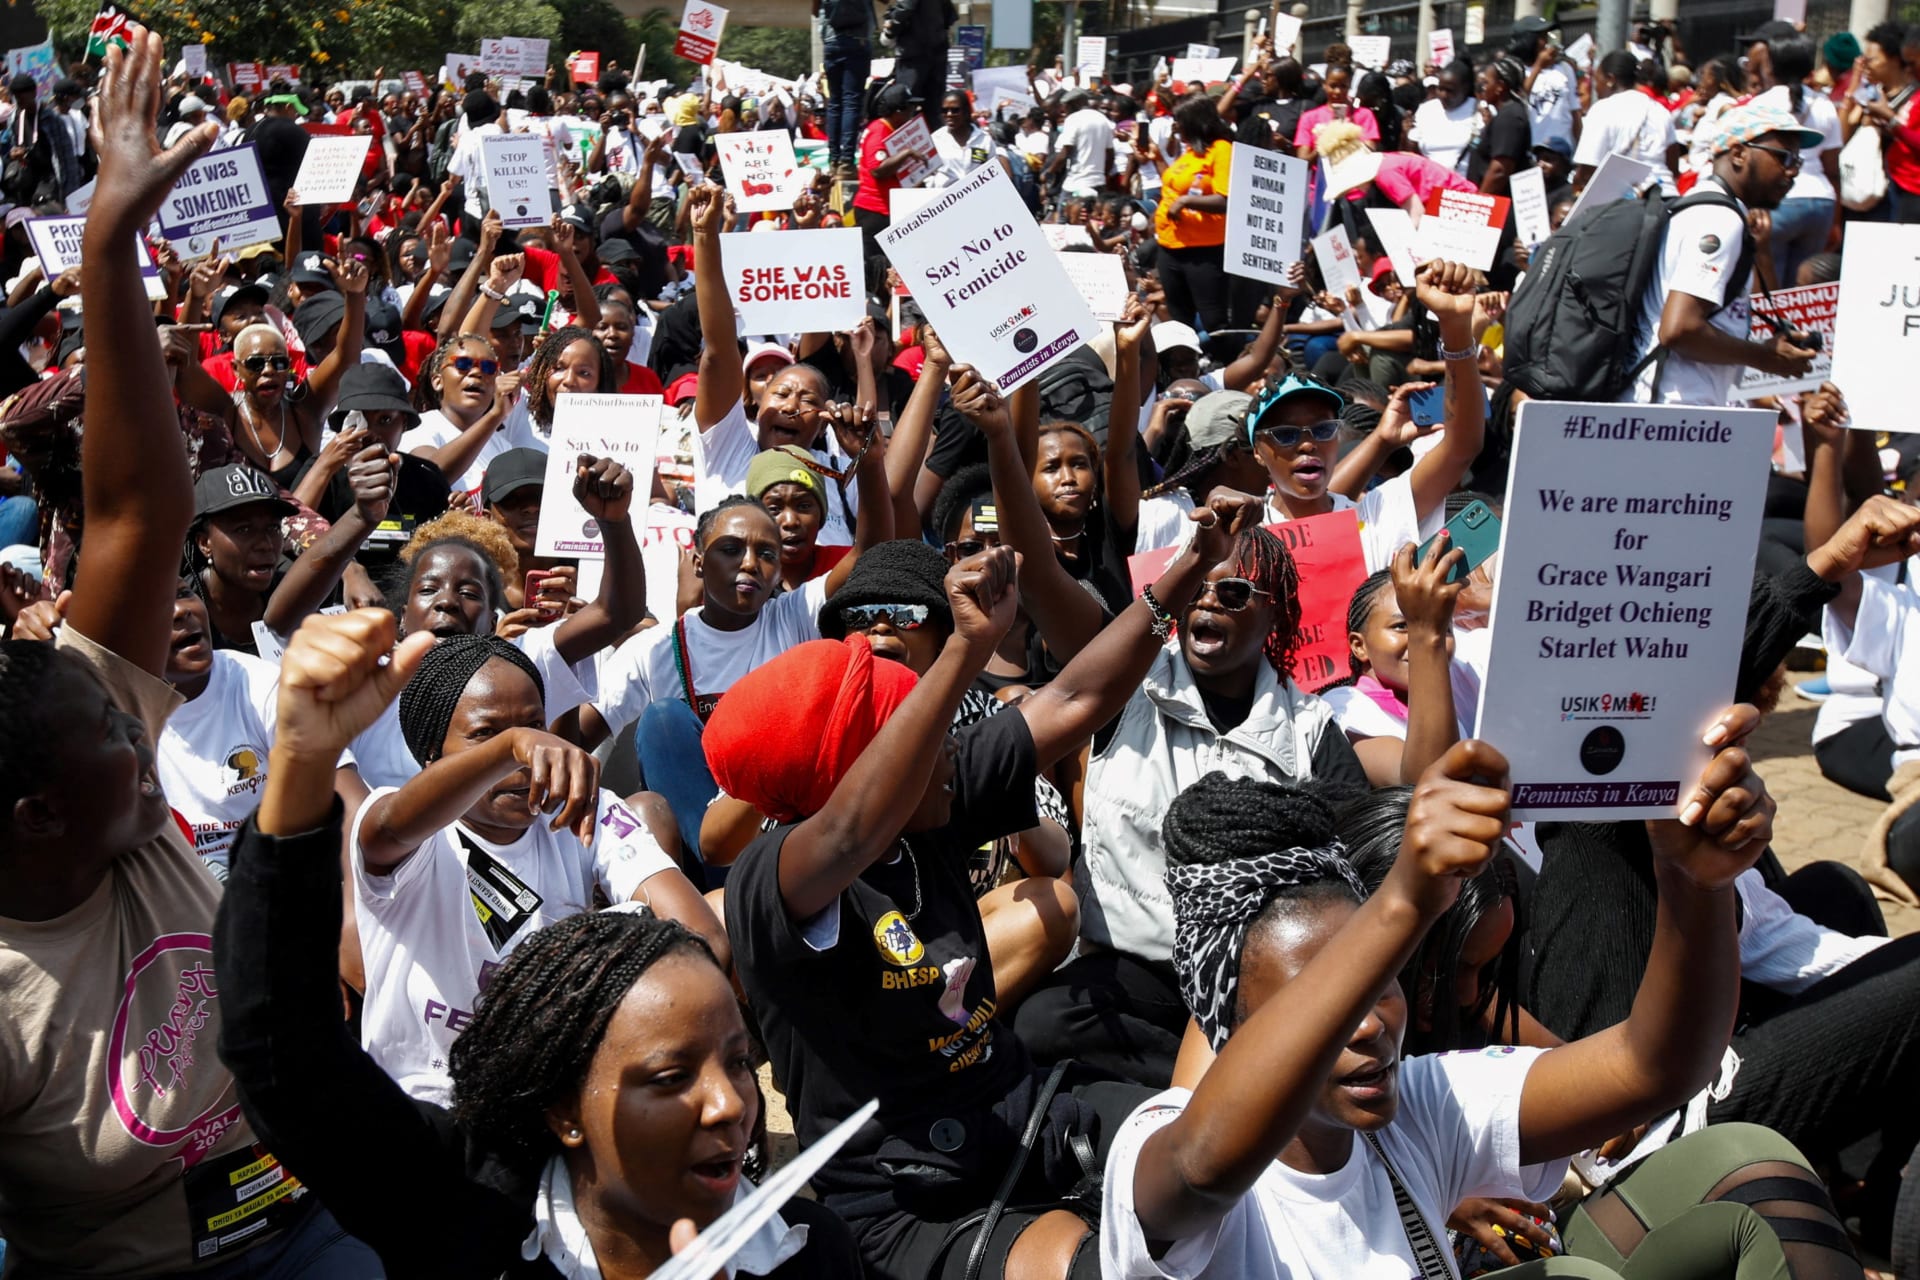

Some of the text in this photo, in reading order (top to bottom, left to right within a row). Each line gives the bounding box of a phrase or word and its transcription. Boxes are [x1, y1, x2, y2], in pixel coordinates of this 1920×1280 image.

[501, 153, 528, 163] STOP
[1254, 155, 1286, 175] BEING A
[203, 160, 238, 182] was
[494, 165, 538, 177] KILLING
[508, 179, 528, 189] US!!
[1252, 174, 1285, 195] WOMAN
[173, 183, 253, 221] SOMEONE!
[887, 165, 999, 245] #TotalShutDownKE
[1250, 195, 1283, 215] SHOULD
[1246, 213, 1284, 234] NOT BE A
[1250, 234, 1277, 253] DEATH
[925, 223, 1014, 287] Say No to
[1242, 252, 1283, 274] SENTENCE
[742, 264, 846, 285] SHE WAS
[942, 248, 1028, 311] Femicide
[739, 281, 851, 302] SOMEONE
[1000, 357, 1040, 388] Feminists
[1050, 332, 1077, 354] Kenya
[1564, 415, 1733, 443] #EndFemicide
[625, 441, 639, 453] to
[1539, 489, 1733, 522] We are marching
[1614, 528, 1649, 551] for
[1538, 563, 1712, 593] Grace Wangari
[1526, 600, 1713, 629] Bridget Ochieng
[1538, 636, 1689, 659] Starlet Wahu
[1515, 783, 1678, 806] Feminists in Kenya
[491, 893, 511, 915] UNITED
[882, 965, 939, 990] BHESP
